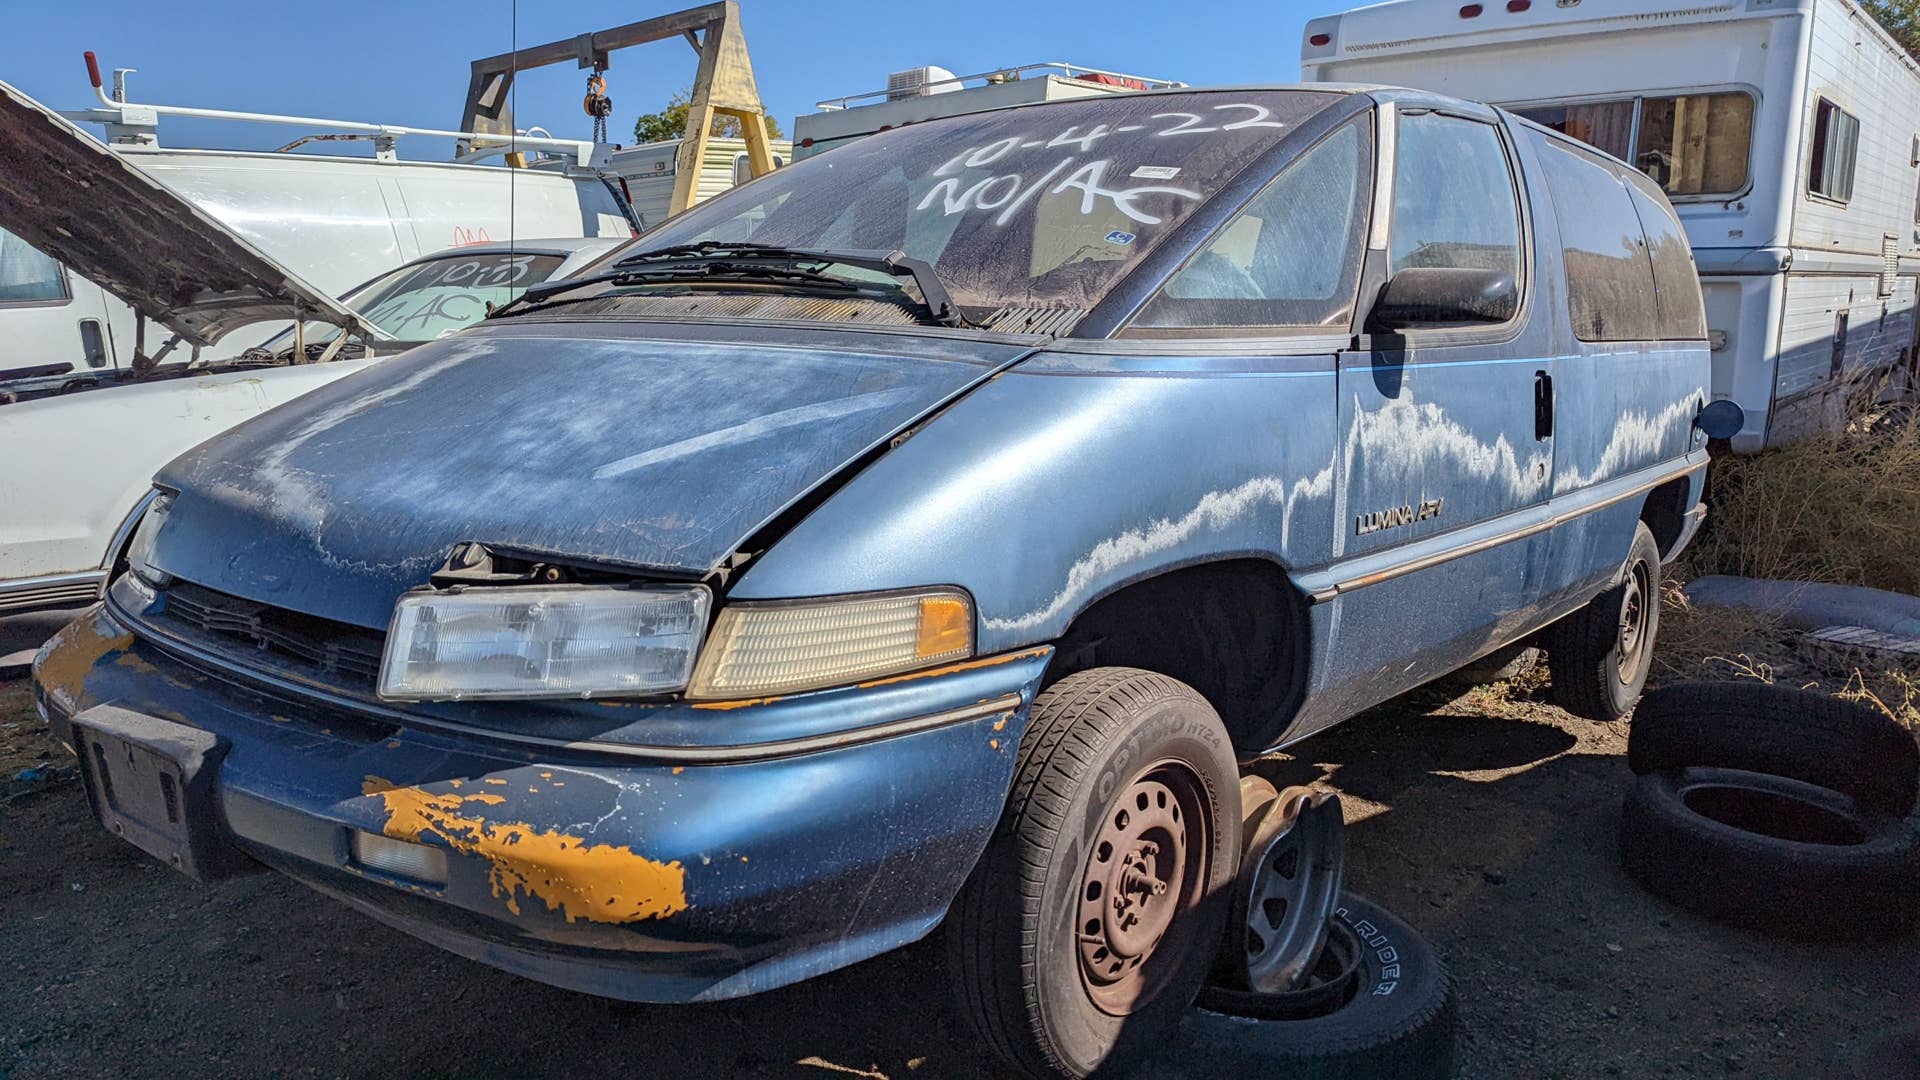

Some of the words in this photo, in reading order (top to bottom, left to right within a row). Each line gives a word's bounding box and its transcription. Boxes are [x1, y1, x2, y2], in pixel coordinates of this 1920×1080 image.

[933, 103, 1285, 177] 10-4-22
[1355, 504, 1414, 536] LUMINA
[1187, 720, 1221, 749] H724
[1353, 920, 1400, 997] RIDER
